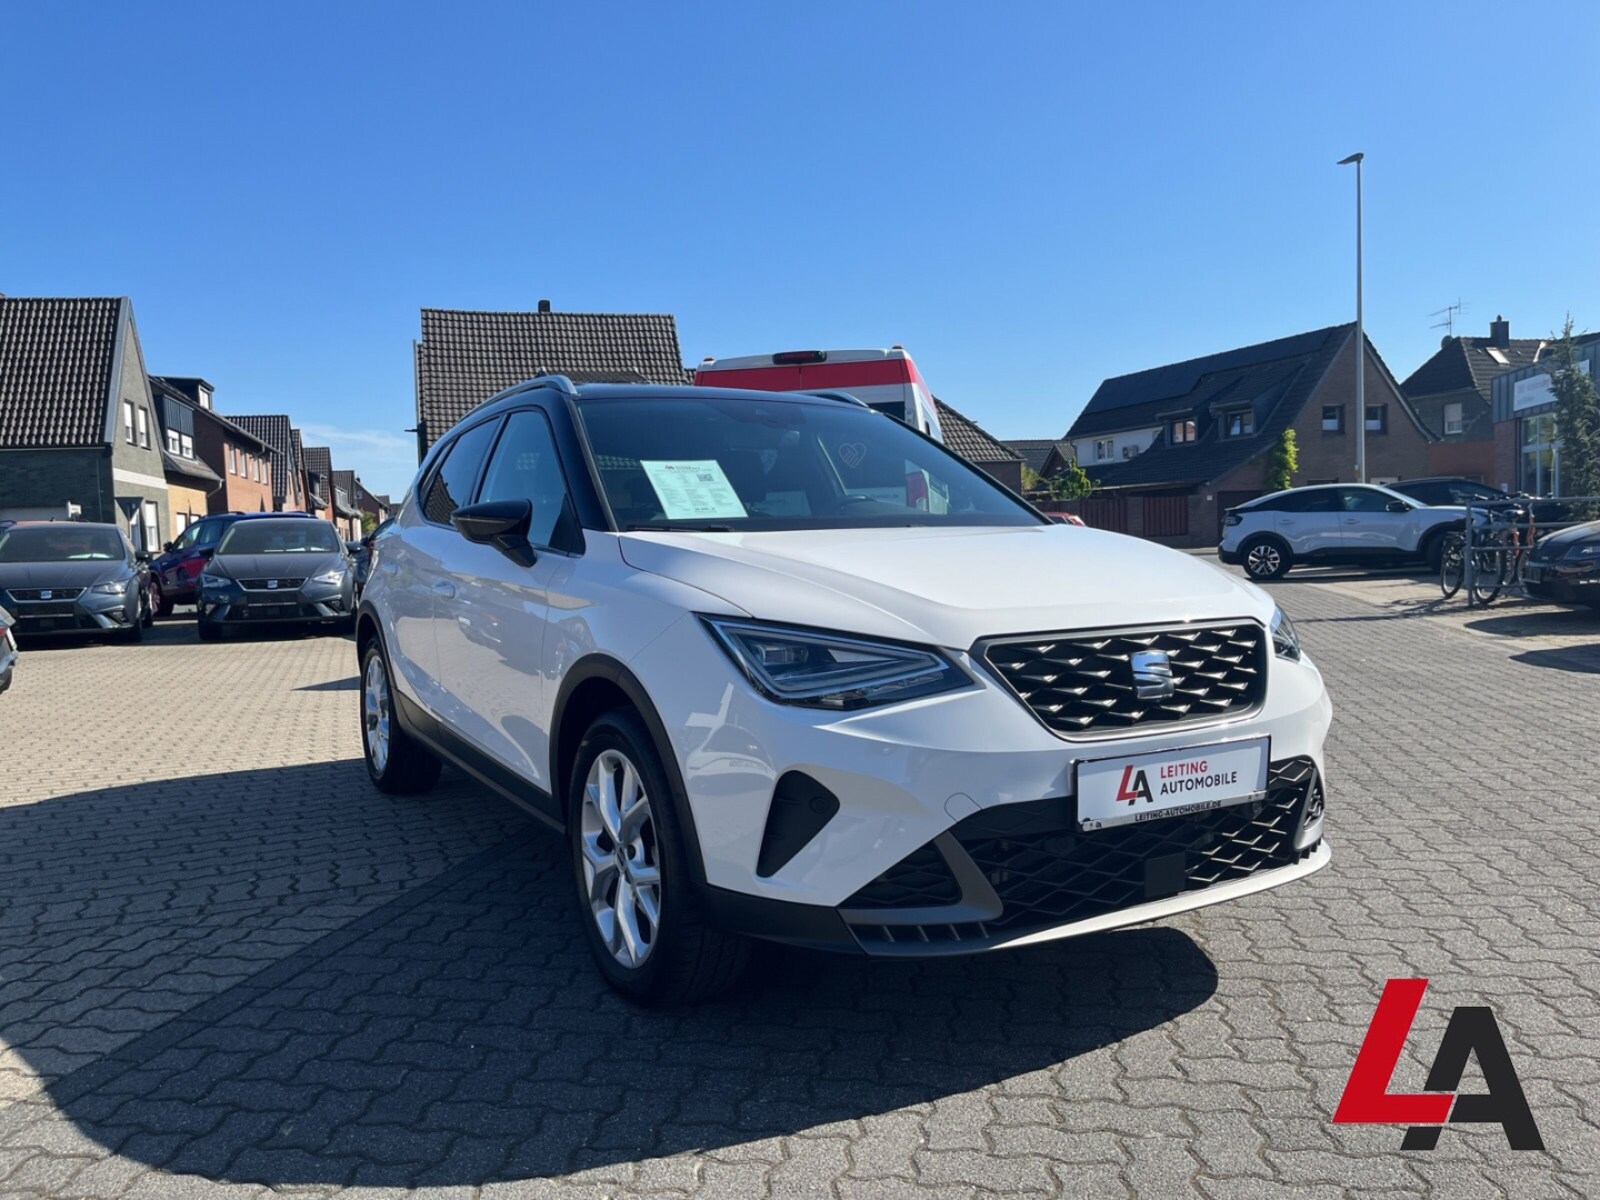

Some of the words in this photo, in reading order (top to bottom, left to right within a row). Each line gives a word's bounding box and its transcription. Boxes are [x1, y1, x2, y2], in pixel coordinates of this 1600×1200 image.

[1160, 761, 1208, 779] LEITING
[1115, 765, 1154, 806] LA
[1160, 771, 1238, 795] AUTOMOBILE
